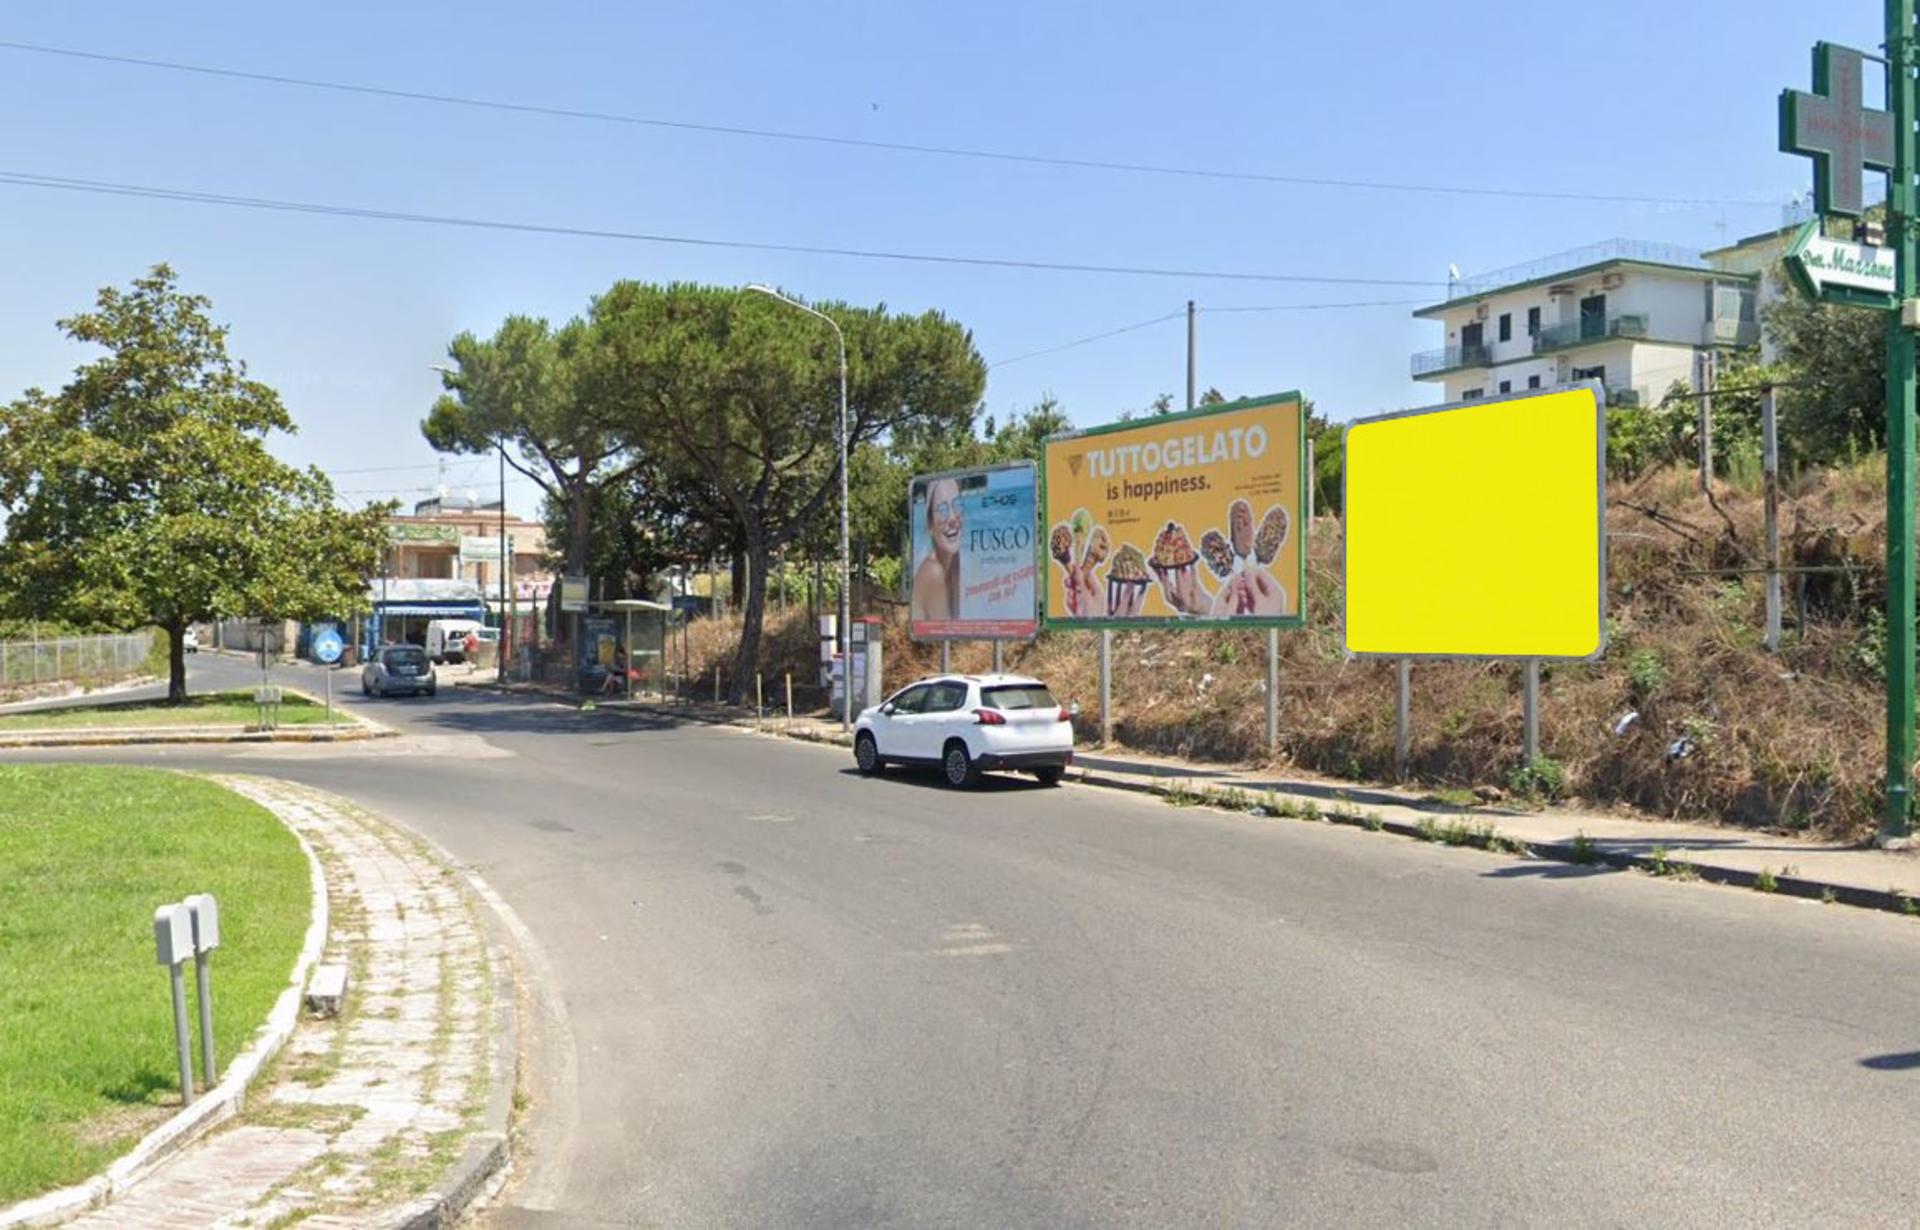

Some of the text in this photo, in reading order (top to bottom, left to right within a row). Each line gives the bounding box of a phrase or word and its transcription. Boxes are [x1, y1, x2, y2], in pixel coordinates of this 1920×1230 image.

[1087, 424, 1268, 479] TUTTOGELATO
[1106, 482, 1119, 501] is
[1123, 474, 1211, 502] happiness.
[970, 525, 1030, 553] FUSCO
